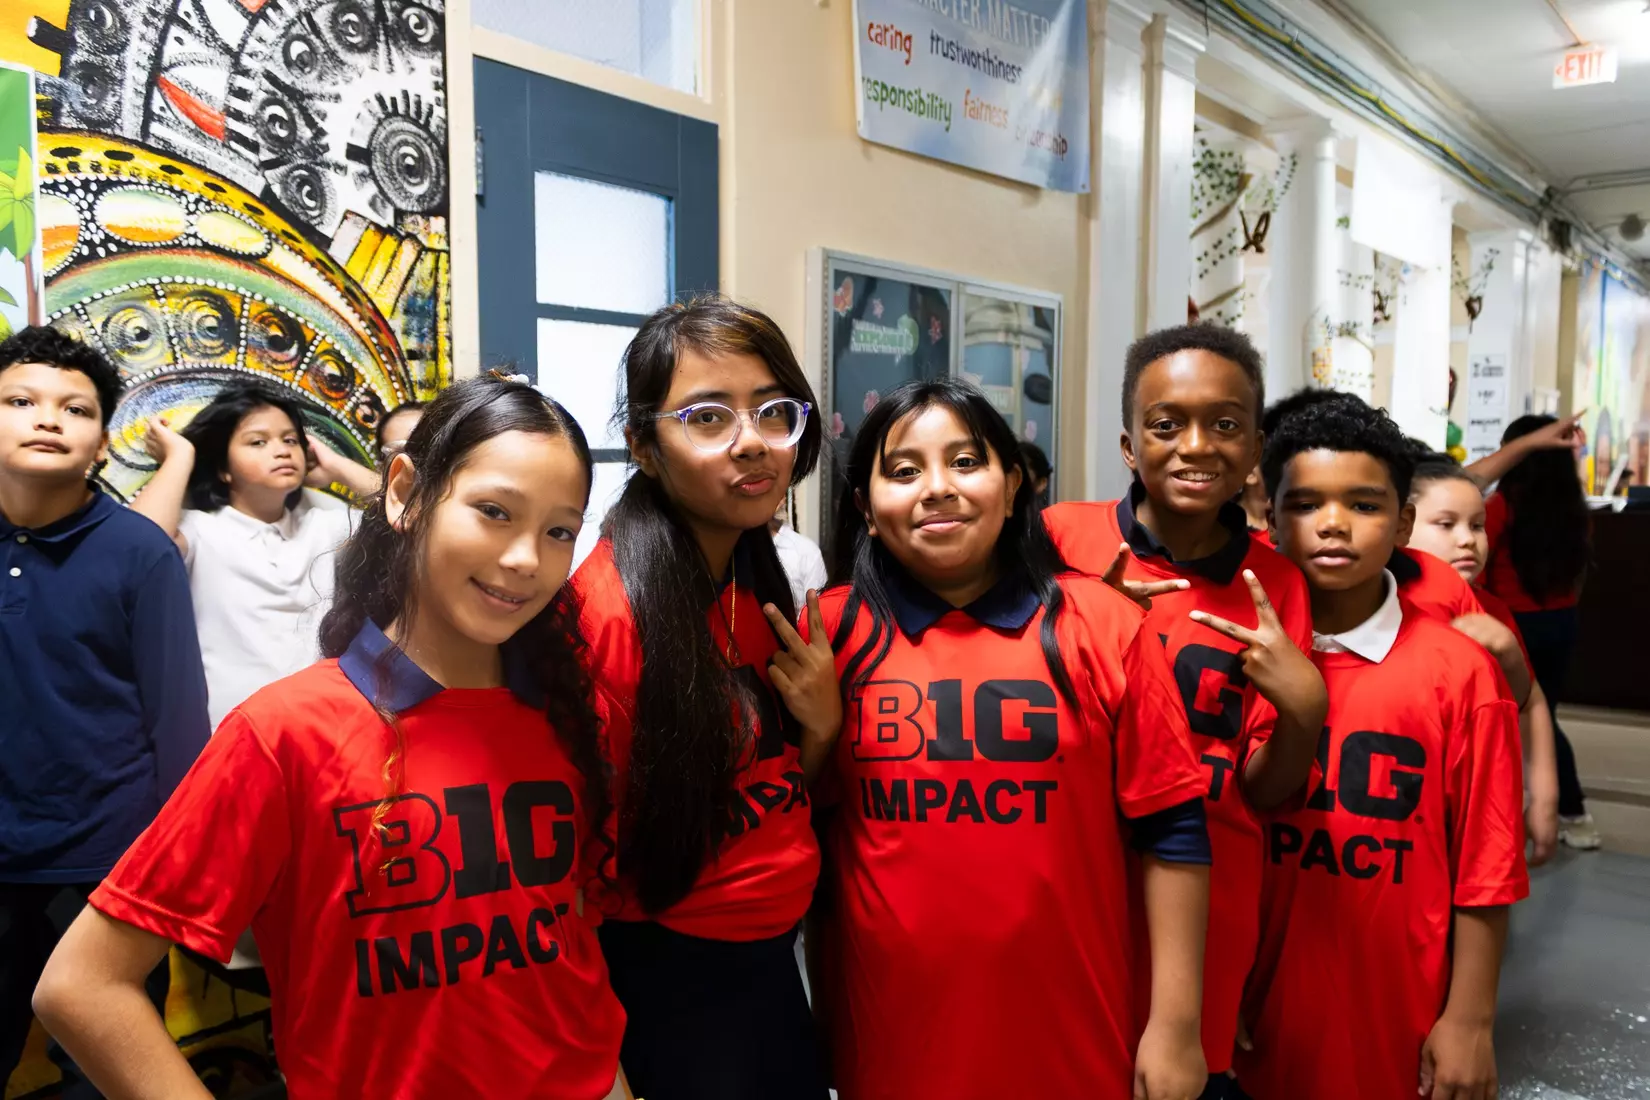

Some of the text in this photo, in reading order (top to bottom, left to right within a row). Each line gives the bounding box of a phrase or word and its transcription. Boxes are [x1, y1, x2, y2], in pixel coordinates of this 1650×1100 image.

[868, 21, 1022, 84] caring trustworthiness
[1565, 51, 1605, 81] EXIT
[862, 76, 1008, 132] responsibility fairness
[860, 778, 1058, 824] IMPACT
[1263, 822, 1414, 884] PACT
